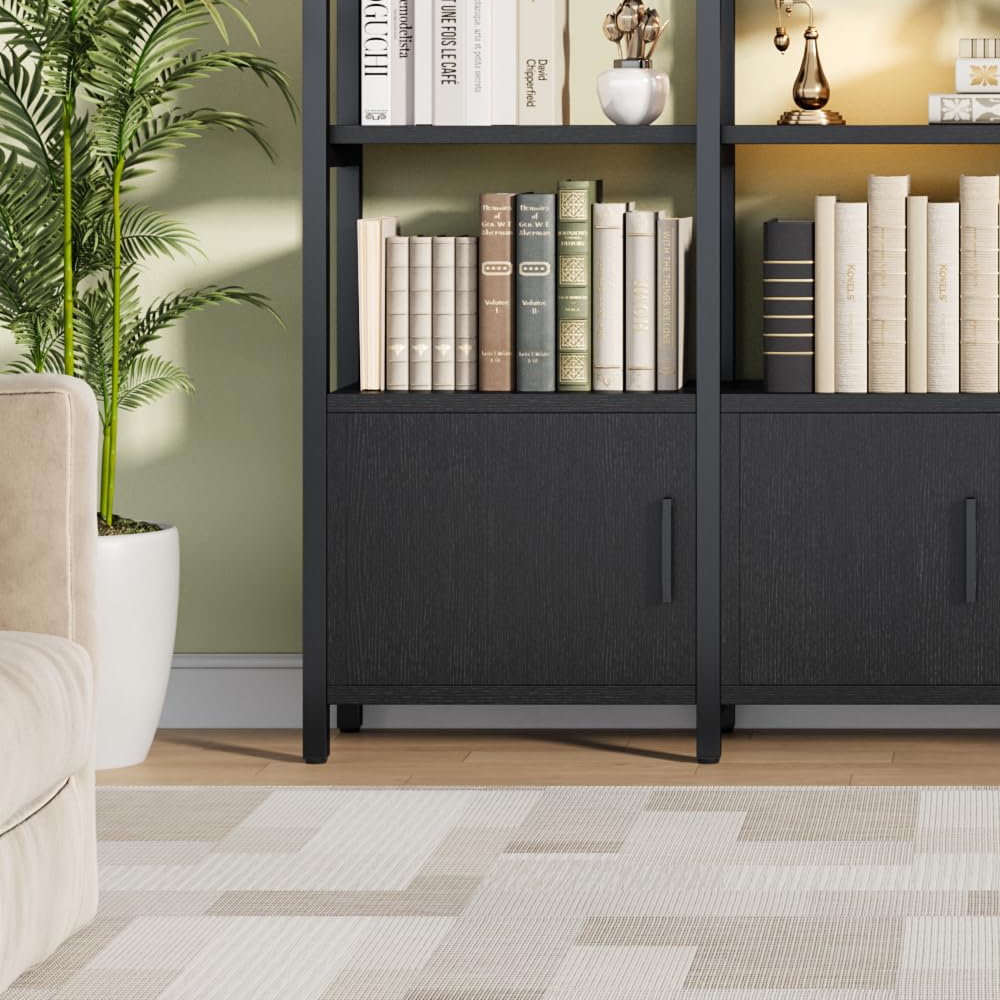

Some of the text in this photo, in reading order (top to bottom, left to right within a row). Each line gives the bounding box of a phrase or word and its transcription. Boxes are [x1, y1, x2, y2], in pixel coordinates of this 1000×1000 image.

[441, 5, 457, 23] UNE
[441, 26, 457, 46] FOIS
[441, 48, 457, 59] LE
[441, 61, 459, 85] CAFÉ
[537, 59, 548, 81] David
[525, 59, 536, 108] Chipperfield
[662, 230, 671, 345] WITH THE THINGS WE LOVE
